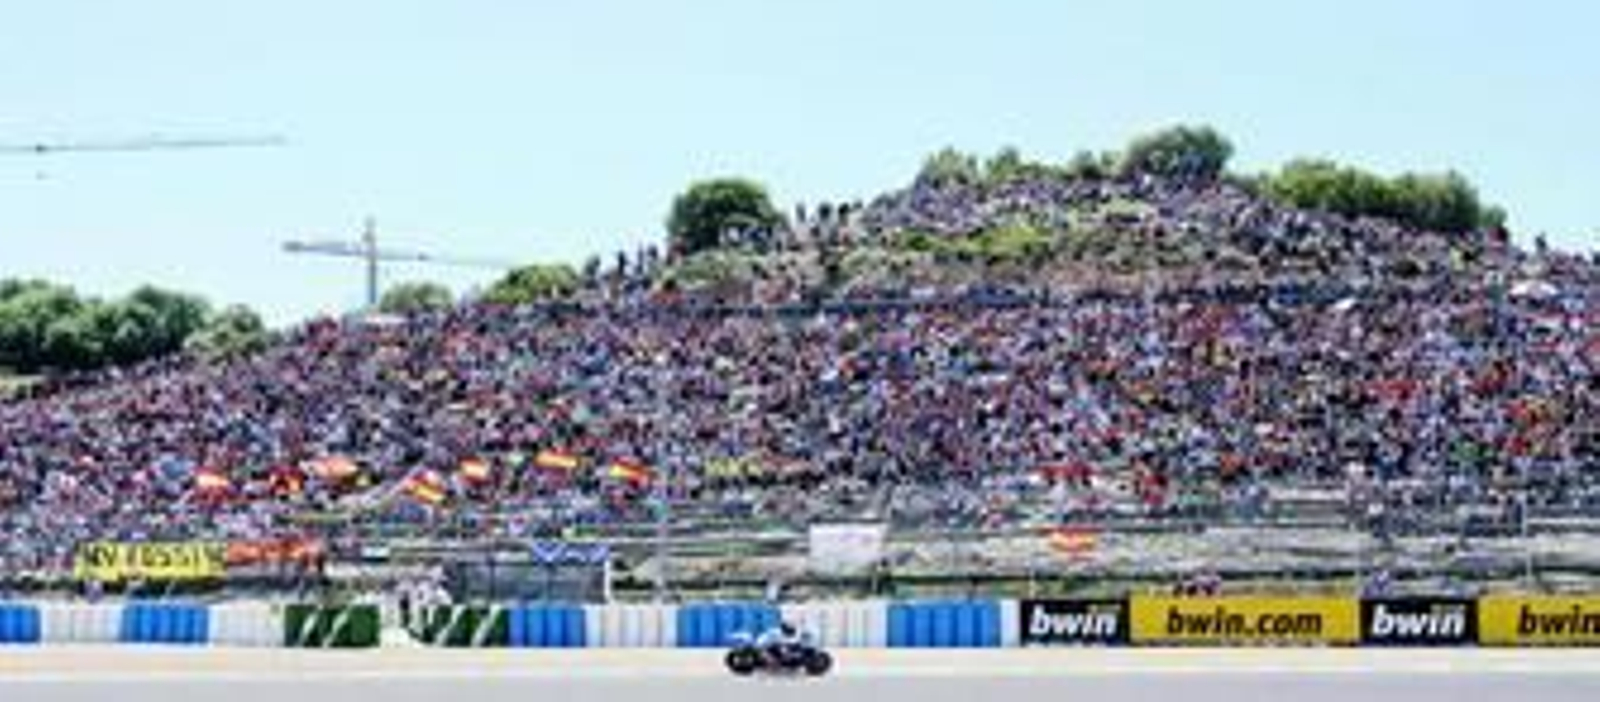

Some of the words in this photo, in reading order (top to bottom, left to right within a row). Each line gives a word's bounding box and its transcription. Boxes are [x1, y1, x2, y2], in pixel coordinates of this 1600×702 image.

[1029, 604, 1118, 636] bwin
[1167, 605, 1323, 635] bwin.com
[1371, 603, 1466, 637] bwin
[1517, 604, 1600, 635] bwin
